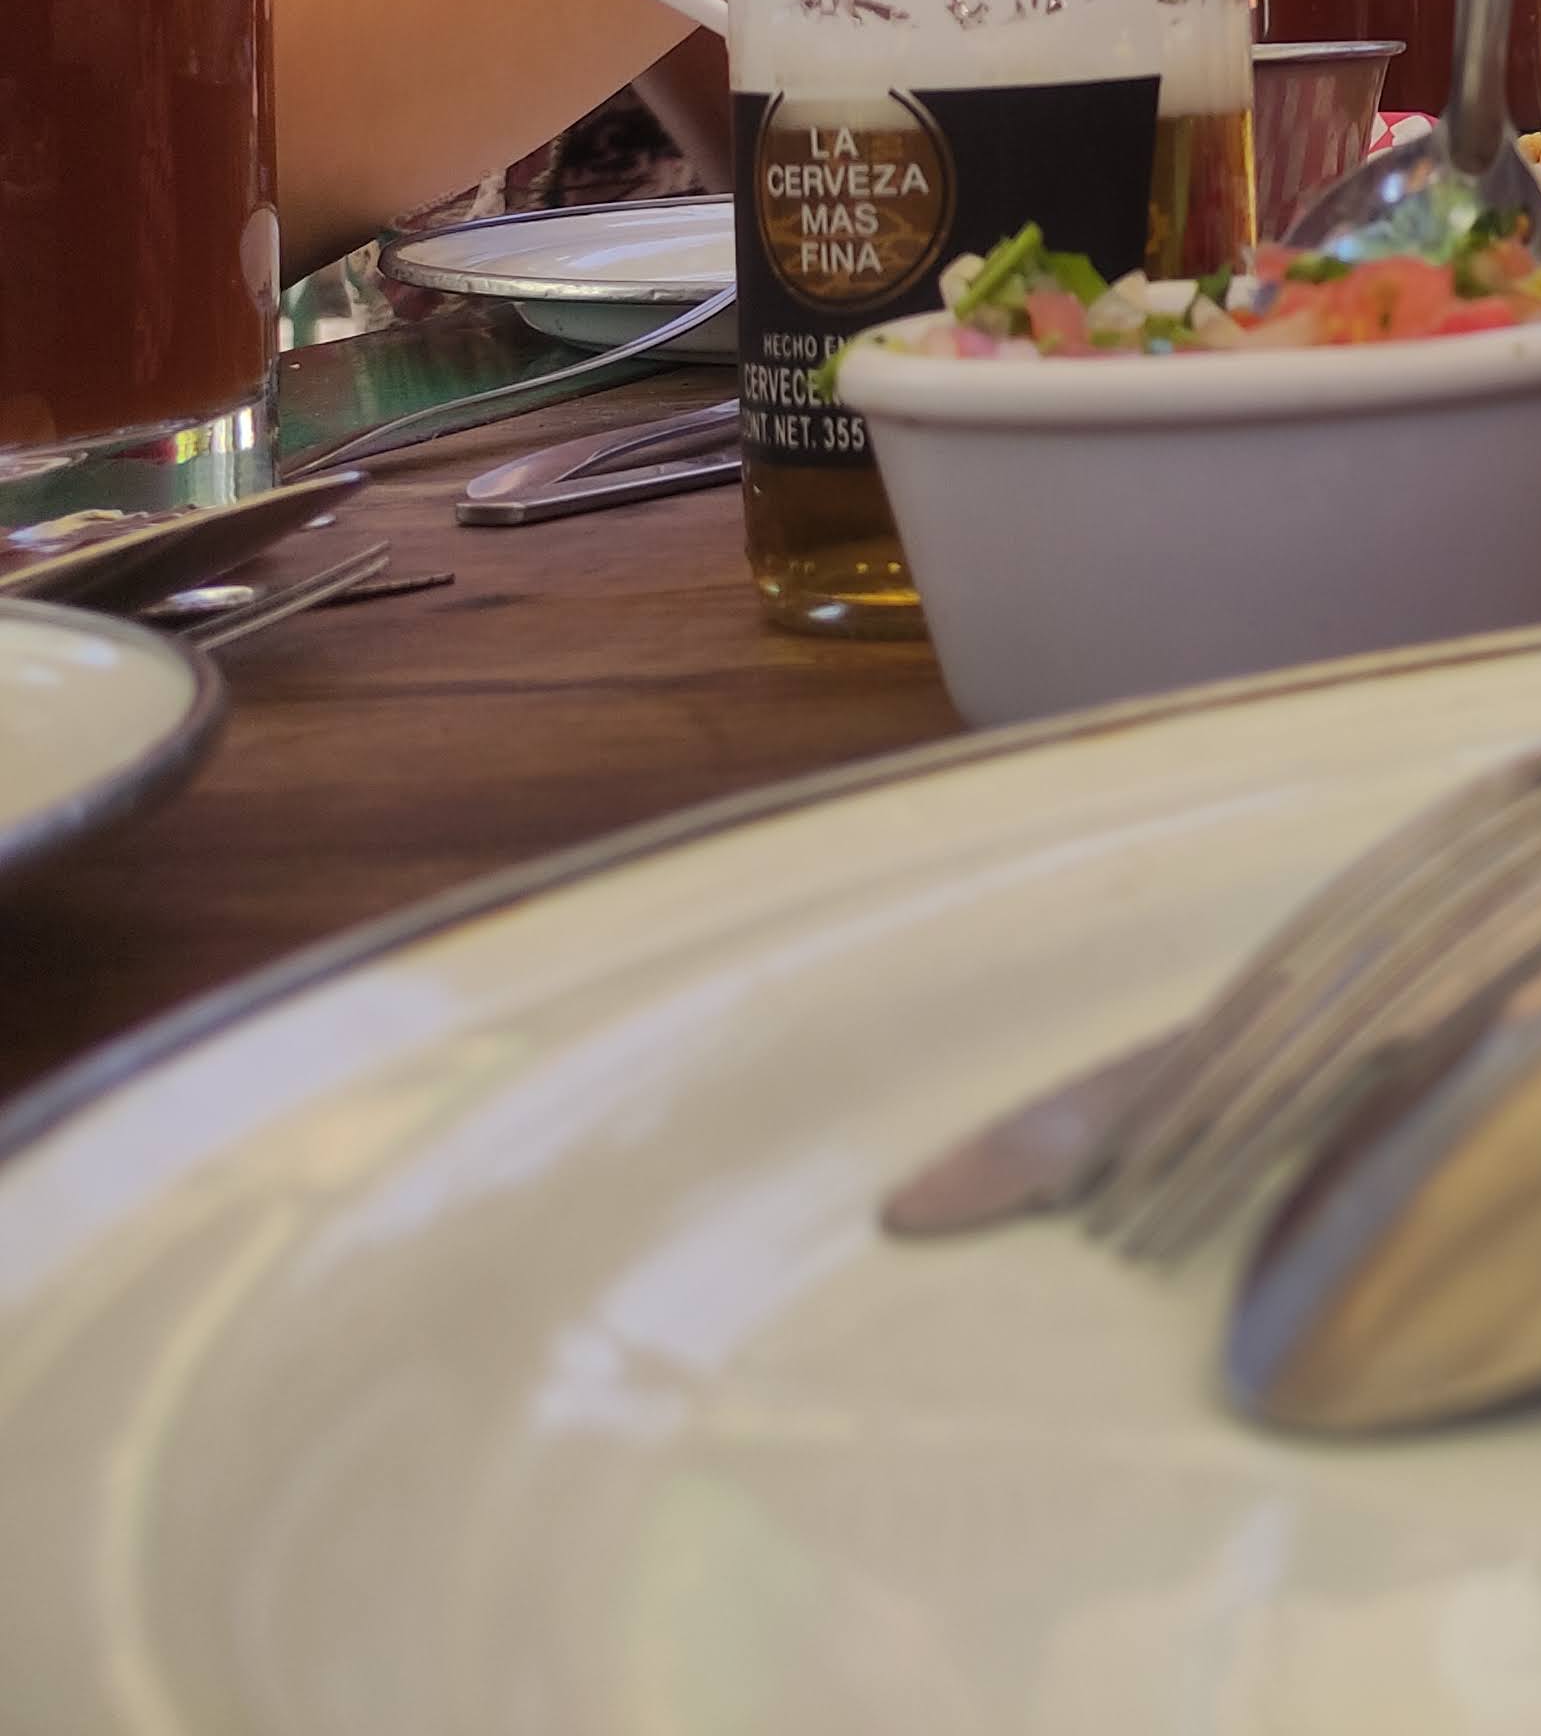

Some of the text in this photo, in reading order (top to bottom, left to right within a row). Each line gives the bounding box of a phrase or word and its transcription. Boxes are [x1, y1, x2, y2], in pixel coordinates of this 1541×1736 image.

[810, 127, 859, 160] LA
[767, 163, 929, 198] CERVEZA
[801, 203, 879, 237] MAS
[801, 241, 883, 275] FINA
[763, 334, 818, 359] HECHO
[744, 363, 842, 407] CERVECE
[775, 415, 817, 448] NET.
[823, 416, 866, 451] 355
